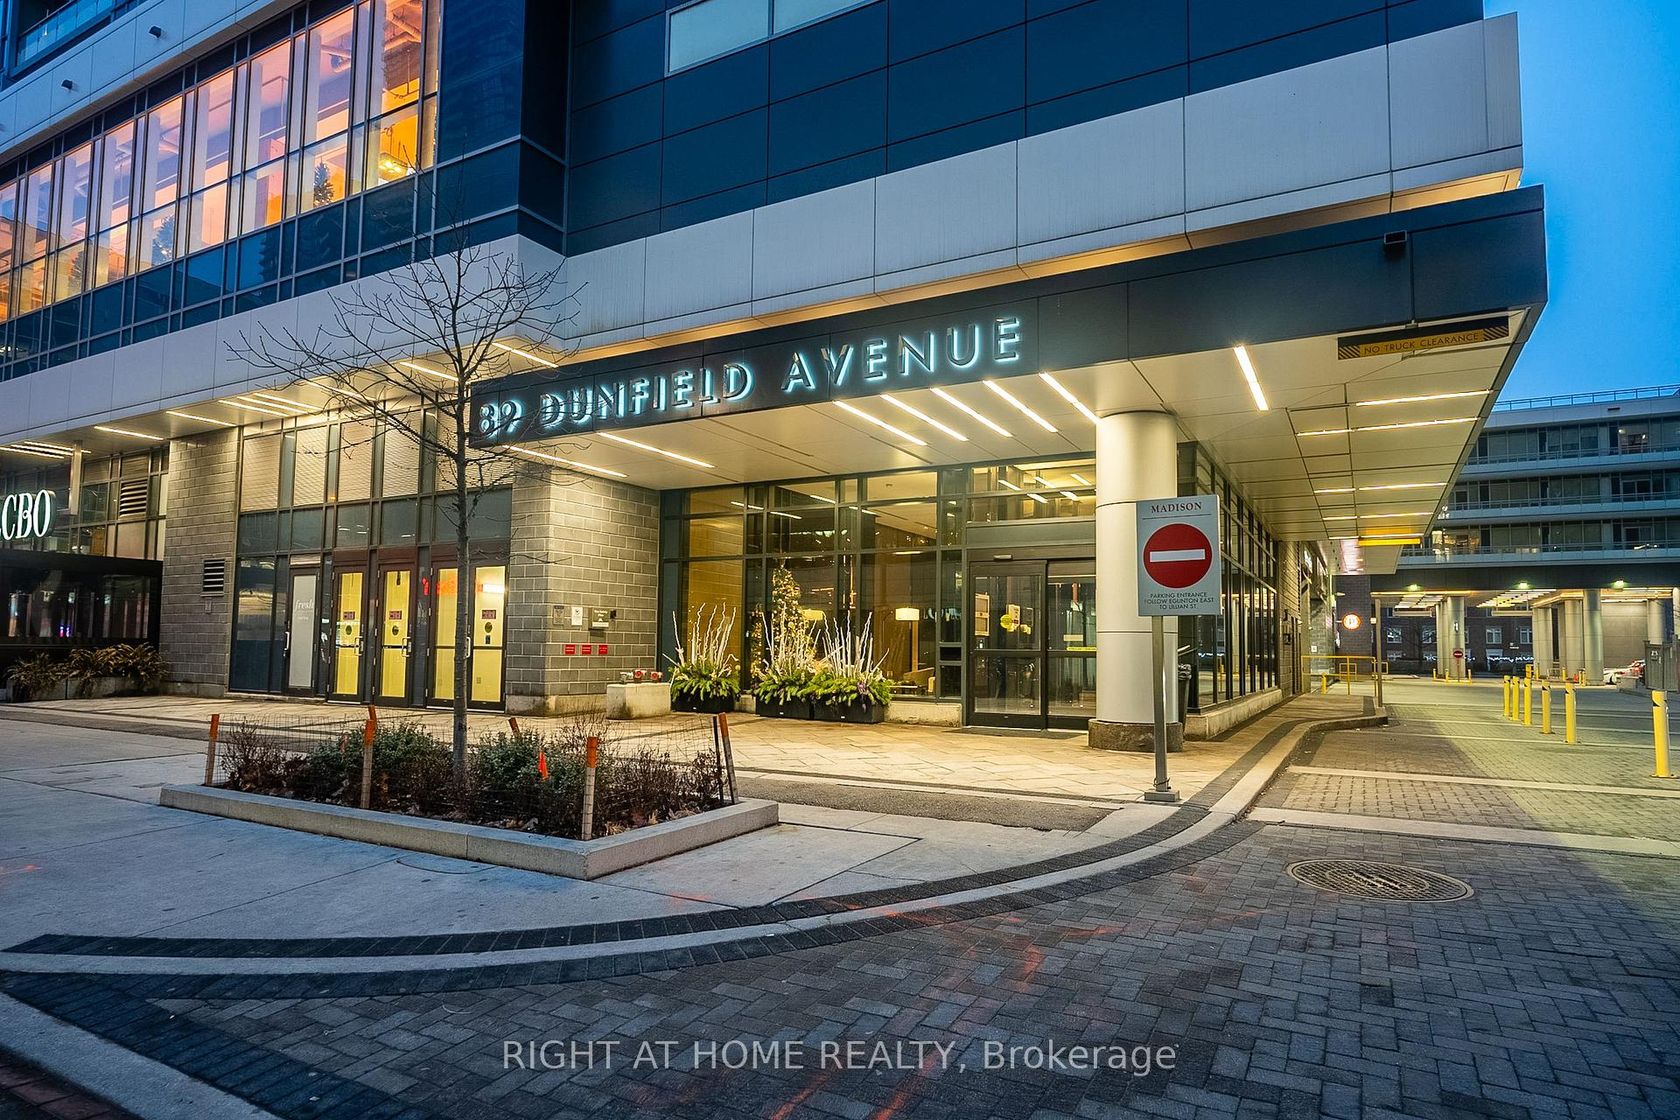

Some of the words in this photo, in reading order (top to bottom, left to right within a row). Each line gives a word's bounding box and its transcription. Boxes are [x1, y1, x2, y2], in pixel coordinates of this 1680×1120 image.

[1364, 345, 1380, 355] NO
[1384, 340, 1415, 353] TRUCK
[1420, 332, 1479, 348] CLEARANCE
[479, 399, 522, 437] 89
[540, 361, 755, 429] DUNFIELD
[781, 316, 1020, 393] AVENUE
[0, 489, 51, 541] CBO
[1151, 501, 1202, 514] MADISON
[1199, 596, 1214, 604] EAST
